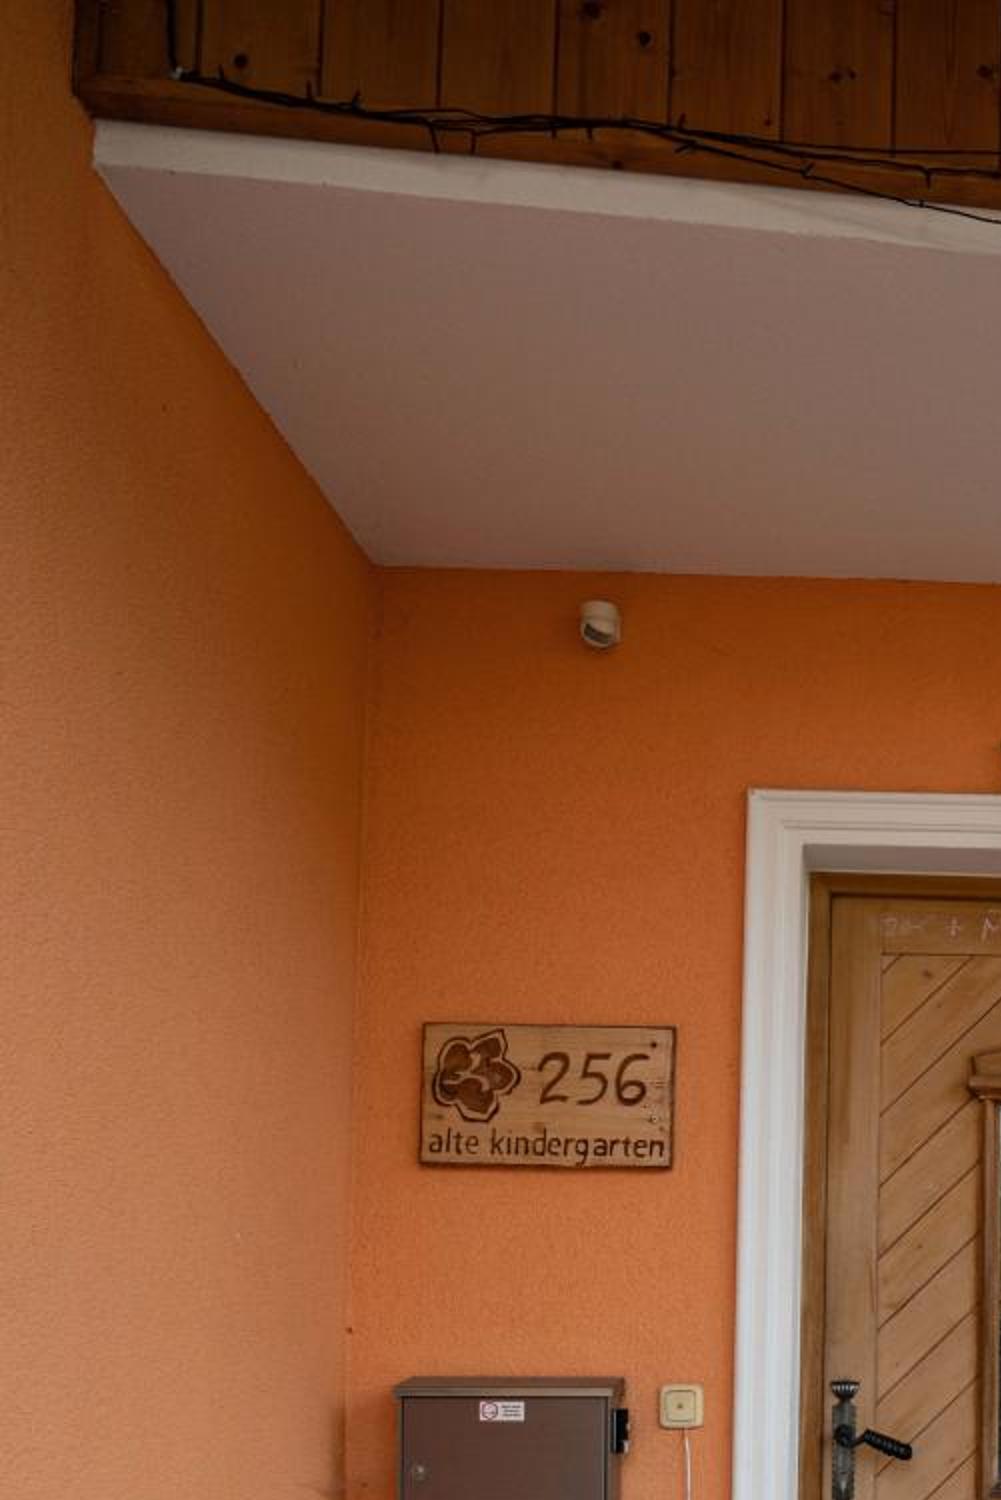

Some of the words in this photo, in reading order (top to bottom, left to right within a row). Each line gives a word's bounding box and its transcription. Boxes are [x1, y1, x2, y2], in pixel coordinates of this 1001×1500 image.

[537, 1051, 651, 1107] 256
[428, 1127, 480, 1156] alte
[489, 1127, 665, 1167] kindergarten
